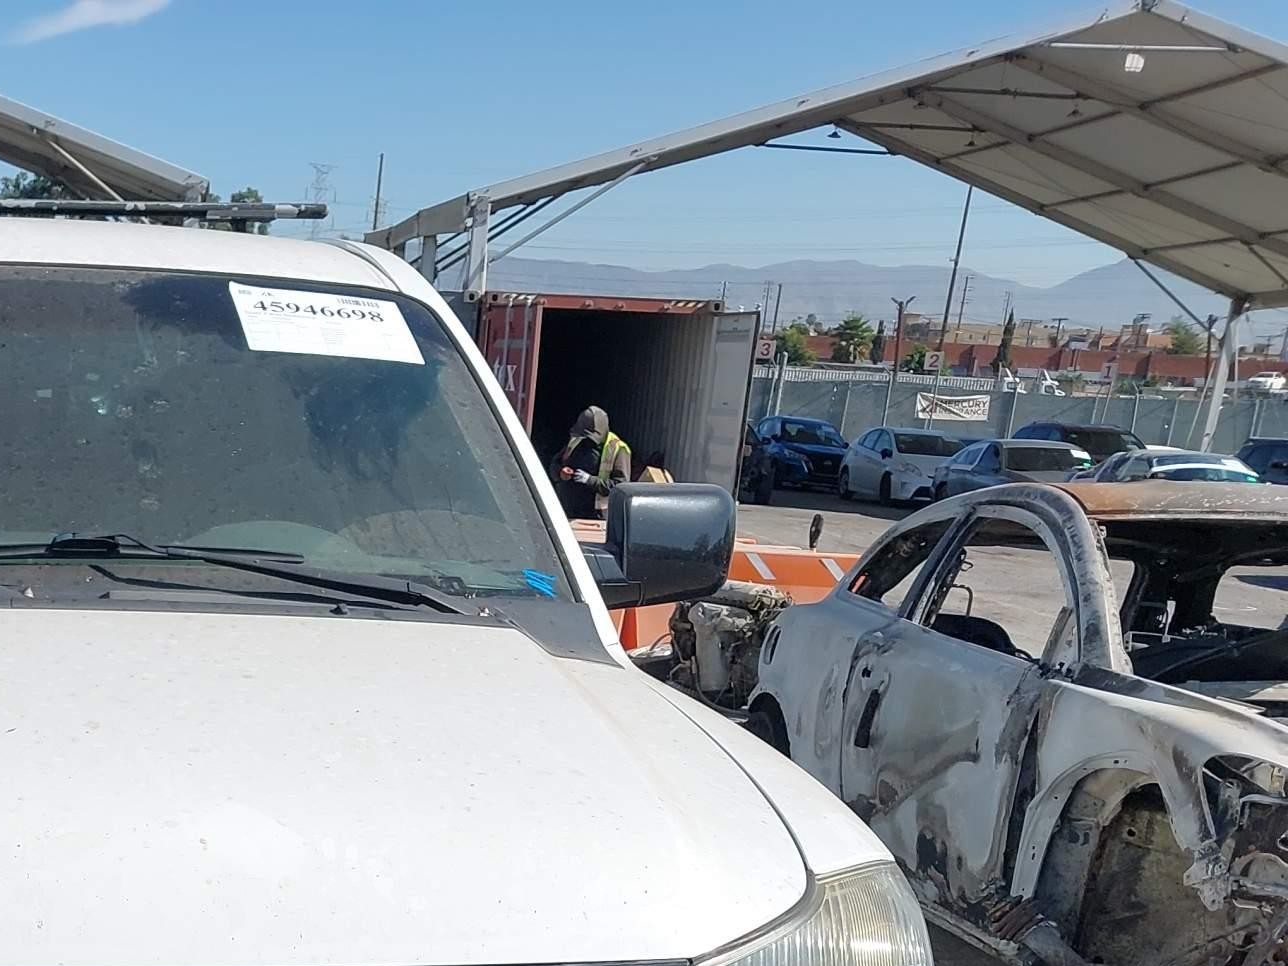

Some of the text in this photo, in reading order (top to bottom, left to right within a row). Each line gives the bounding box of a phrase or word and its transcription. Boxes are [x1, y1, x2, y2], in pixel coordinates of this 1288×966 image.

[253, 300, 384, 322] 45946698
[760, 342, 771, 356] 3
[928, 354, 940, 368] 2
